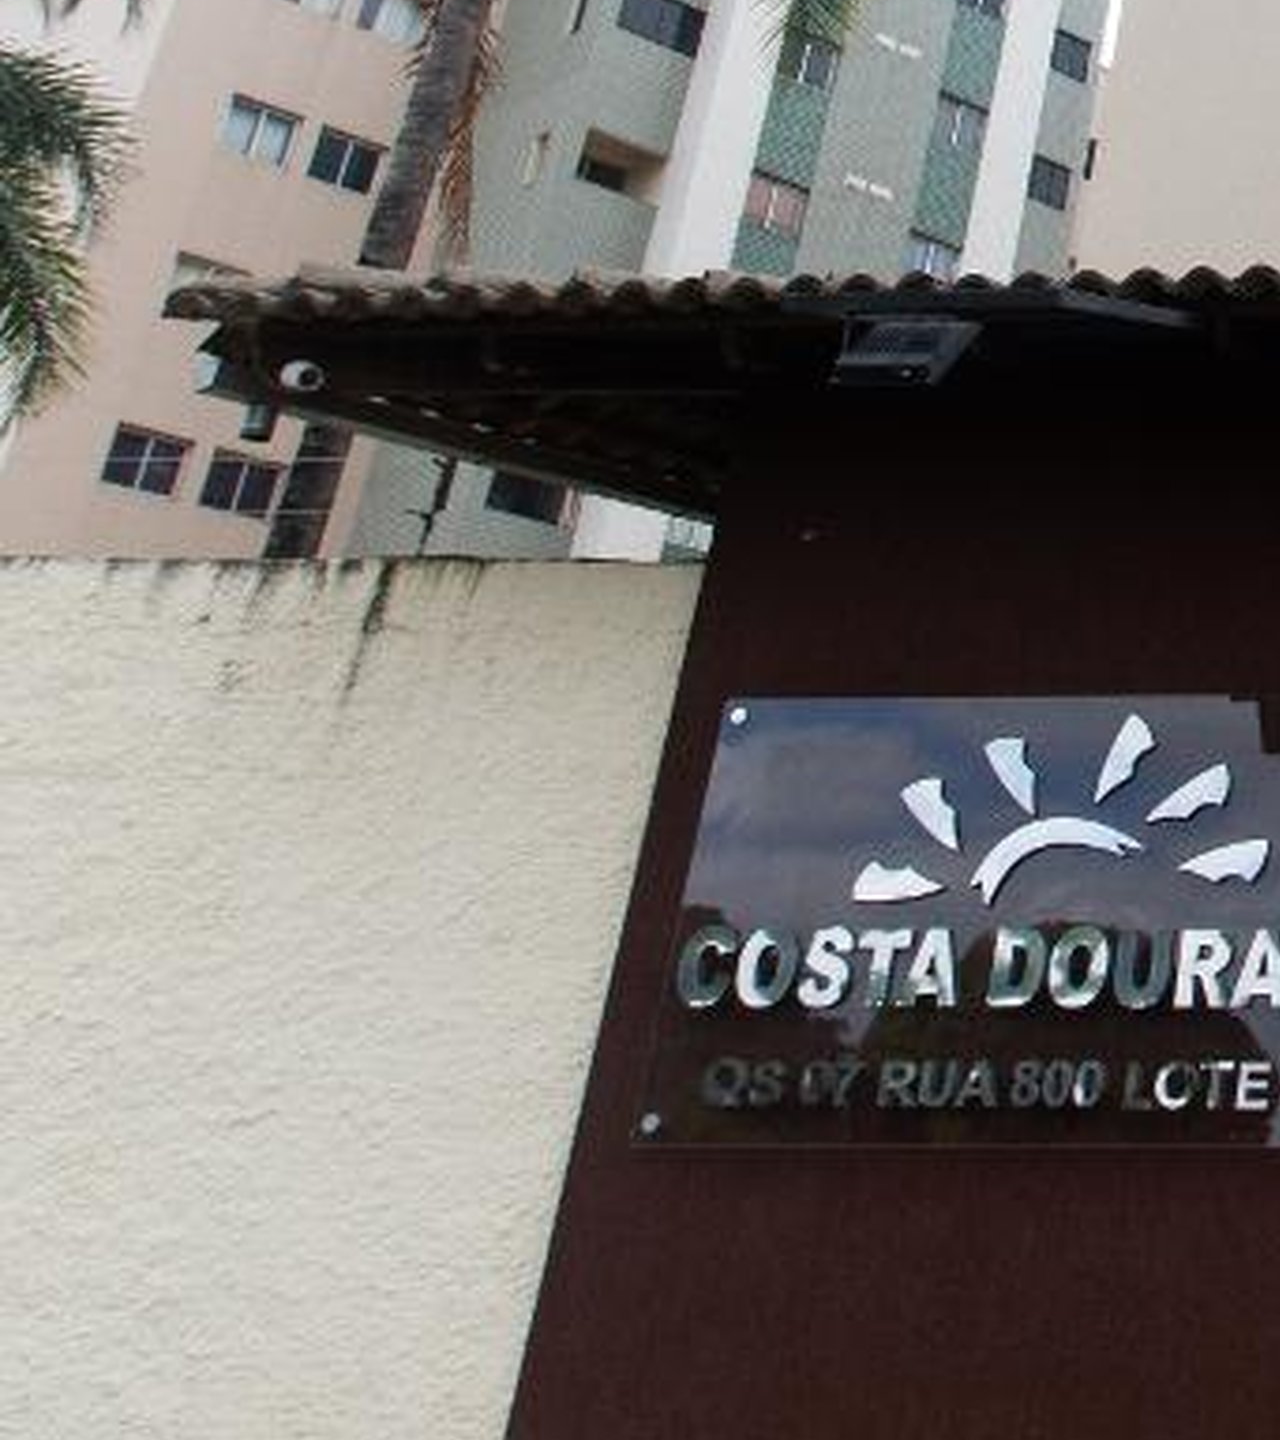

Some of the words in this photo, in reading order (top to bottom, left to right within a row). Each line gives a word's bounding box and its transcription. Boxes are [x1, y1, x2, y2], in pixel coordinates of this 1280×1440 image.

[677, 925, 957, 1008] COSTA
[702, 1056, 785, 1108] QS
[876, 1058, 998, 1109] RUA
[1010, 1057, 1105, 1108] 800
[1121, 1060, 1272, 1110] LOTE
